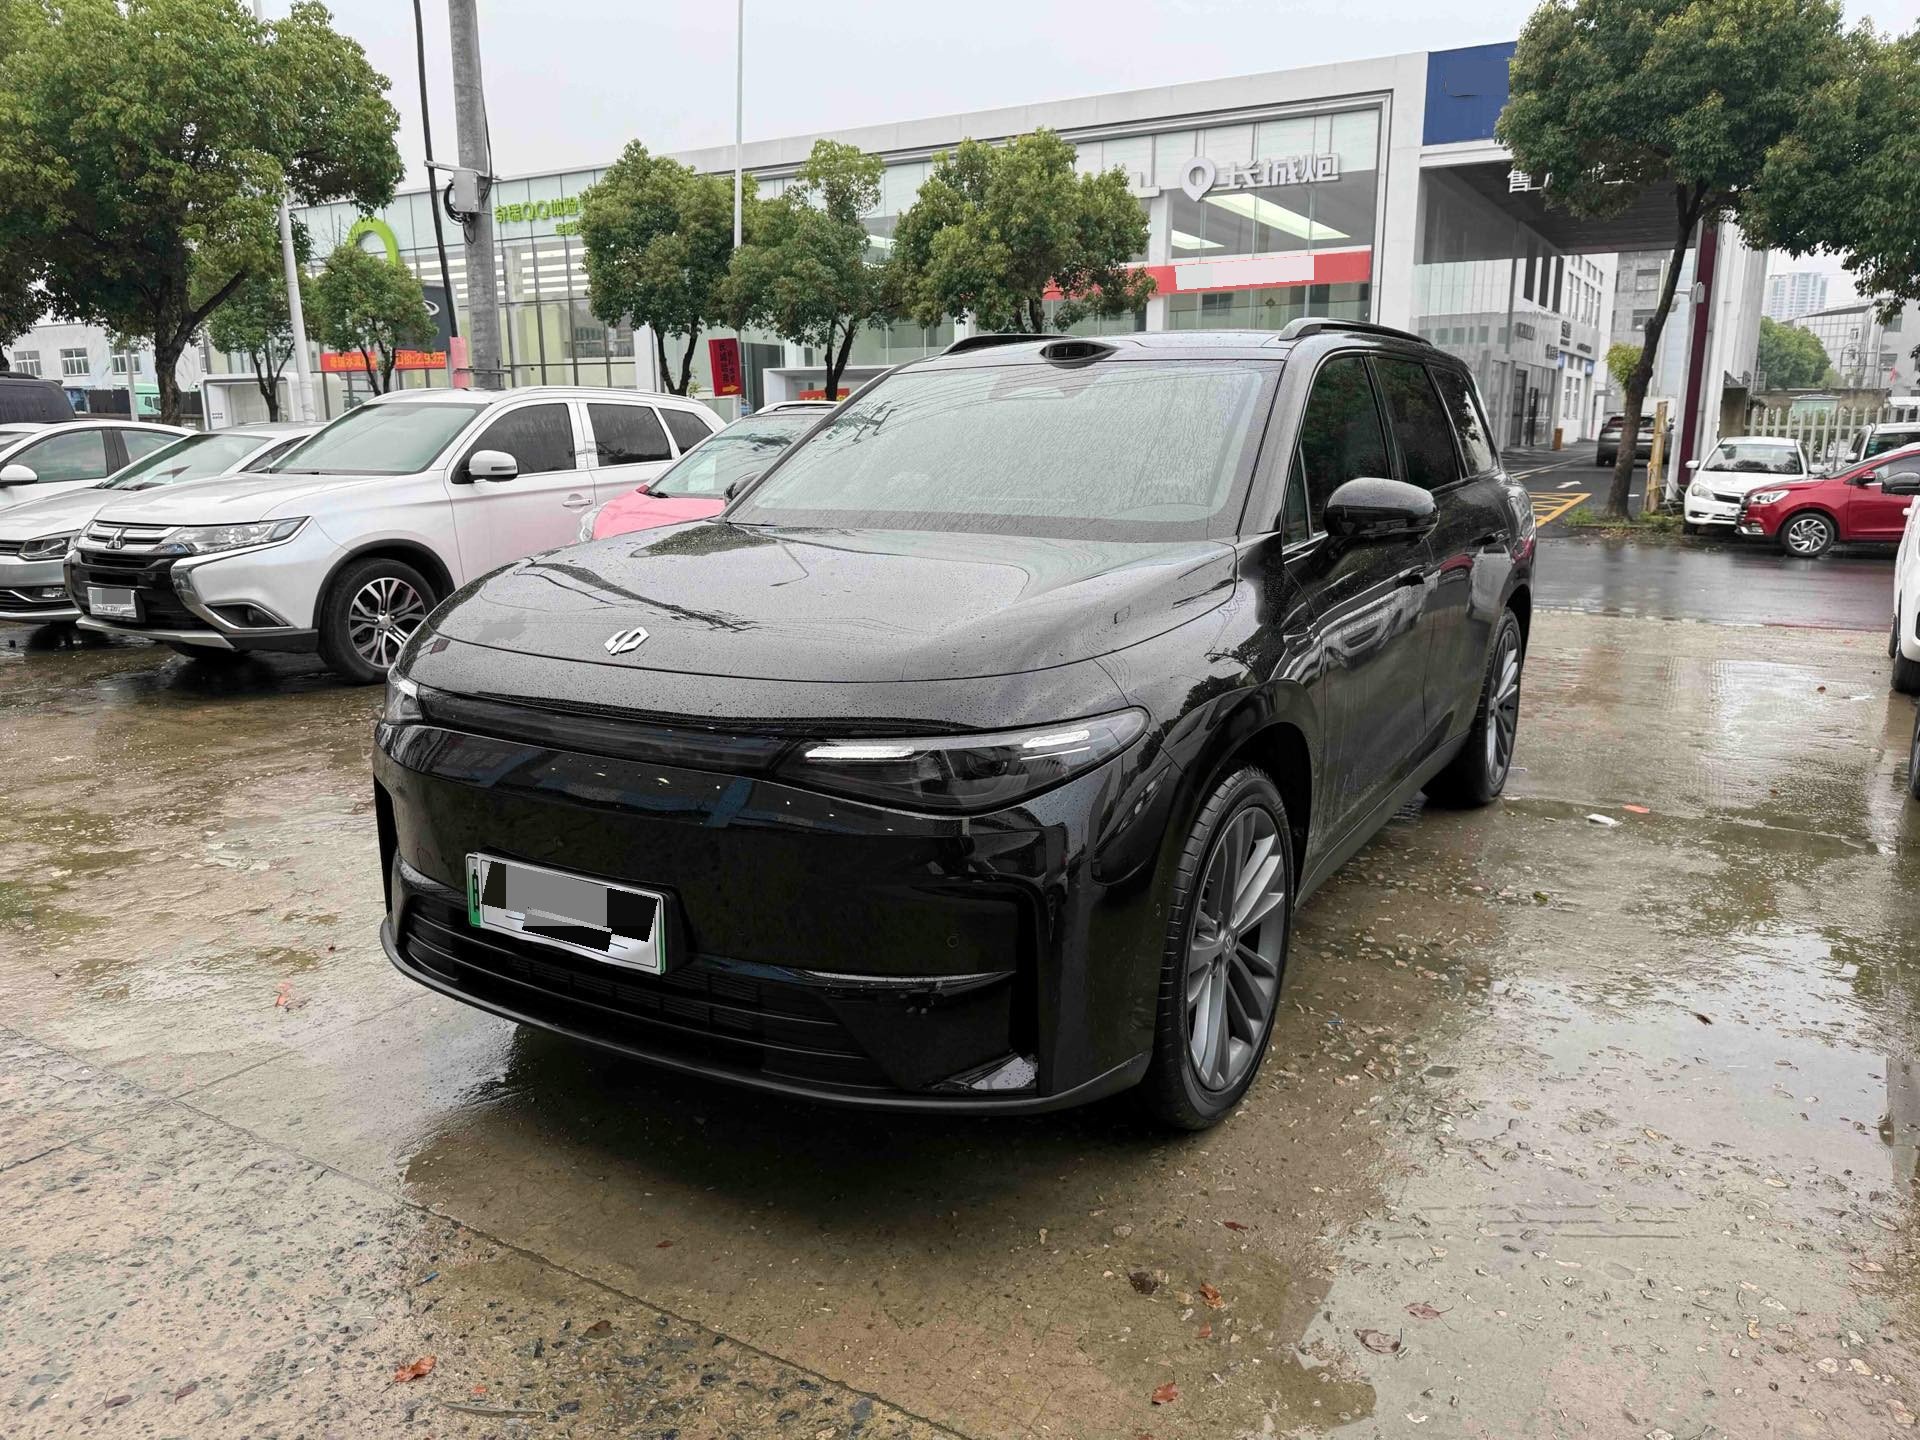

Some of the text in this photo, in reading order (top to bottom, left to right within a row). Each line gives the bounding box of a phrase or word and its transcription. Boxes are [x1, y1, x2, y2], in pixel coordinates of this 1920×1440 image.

[1222, 152, 1339, 189] 长城炮
[495, 196, 585, 224] 奇瑞QQ体验
